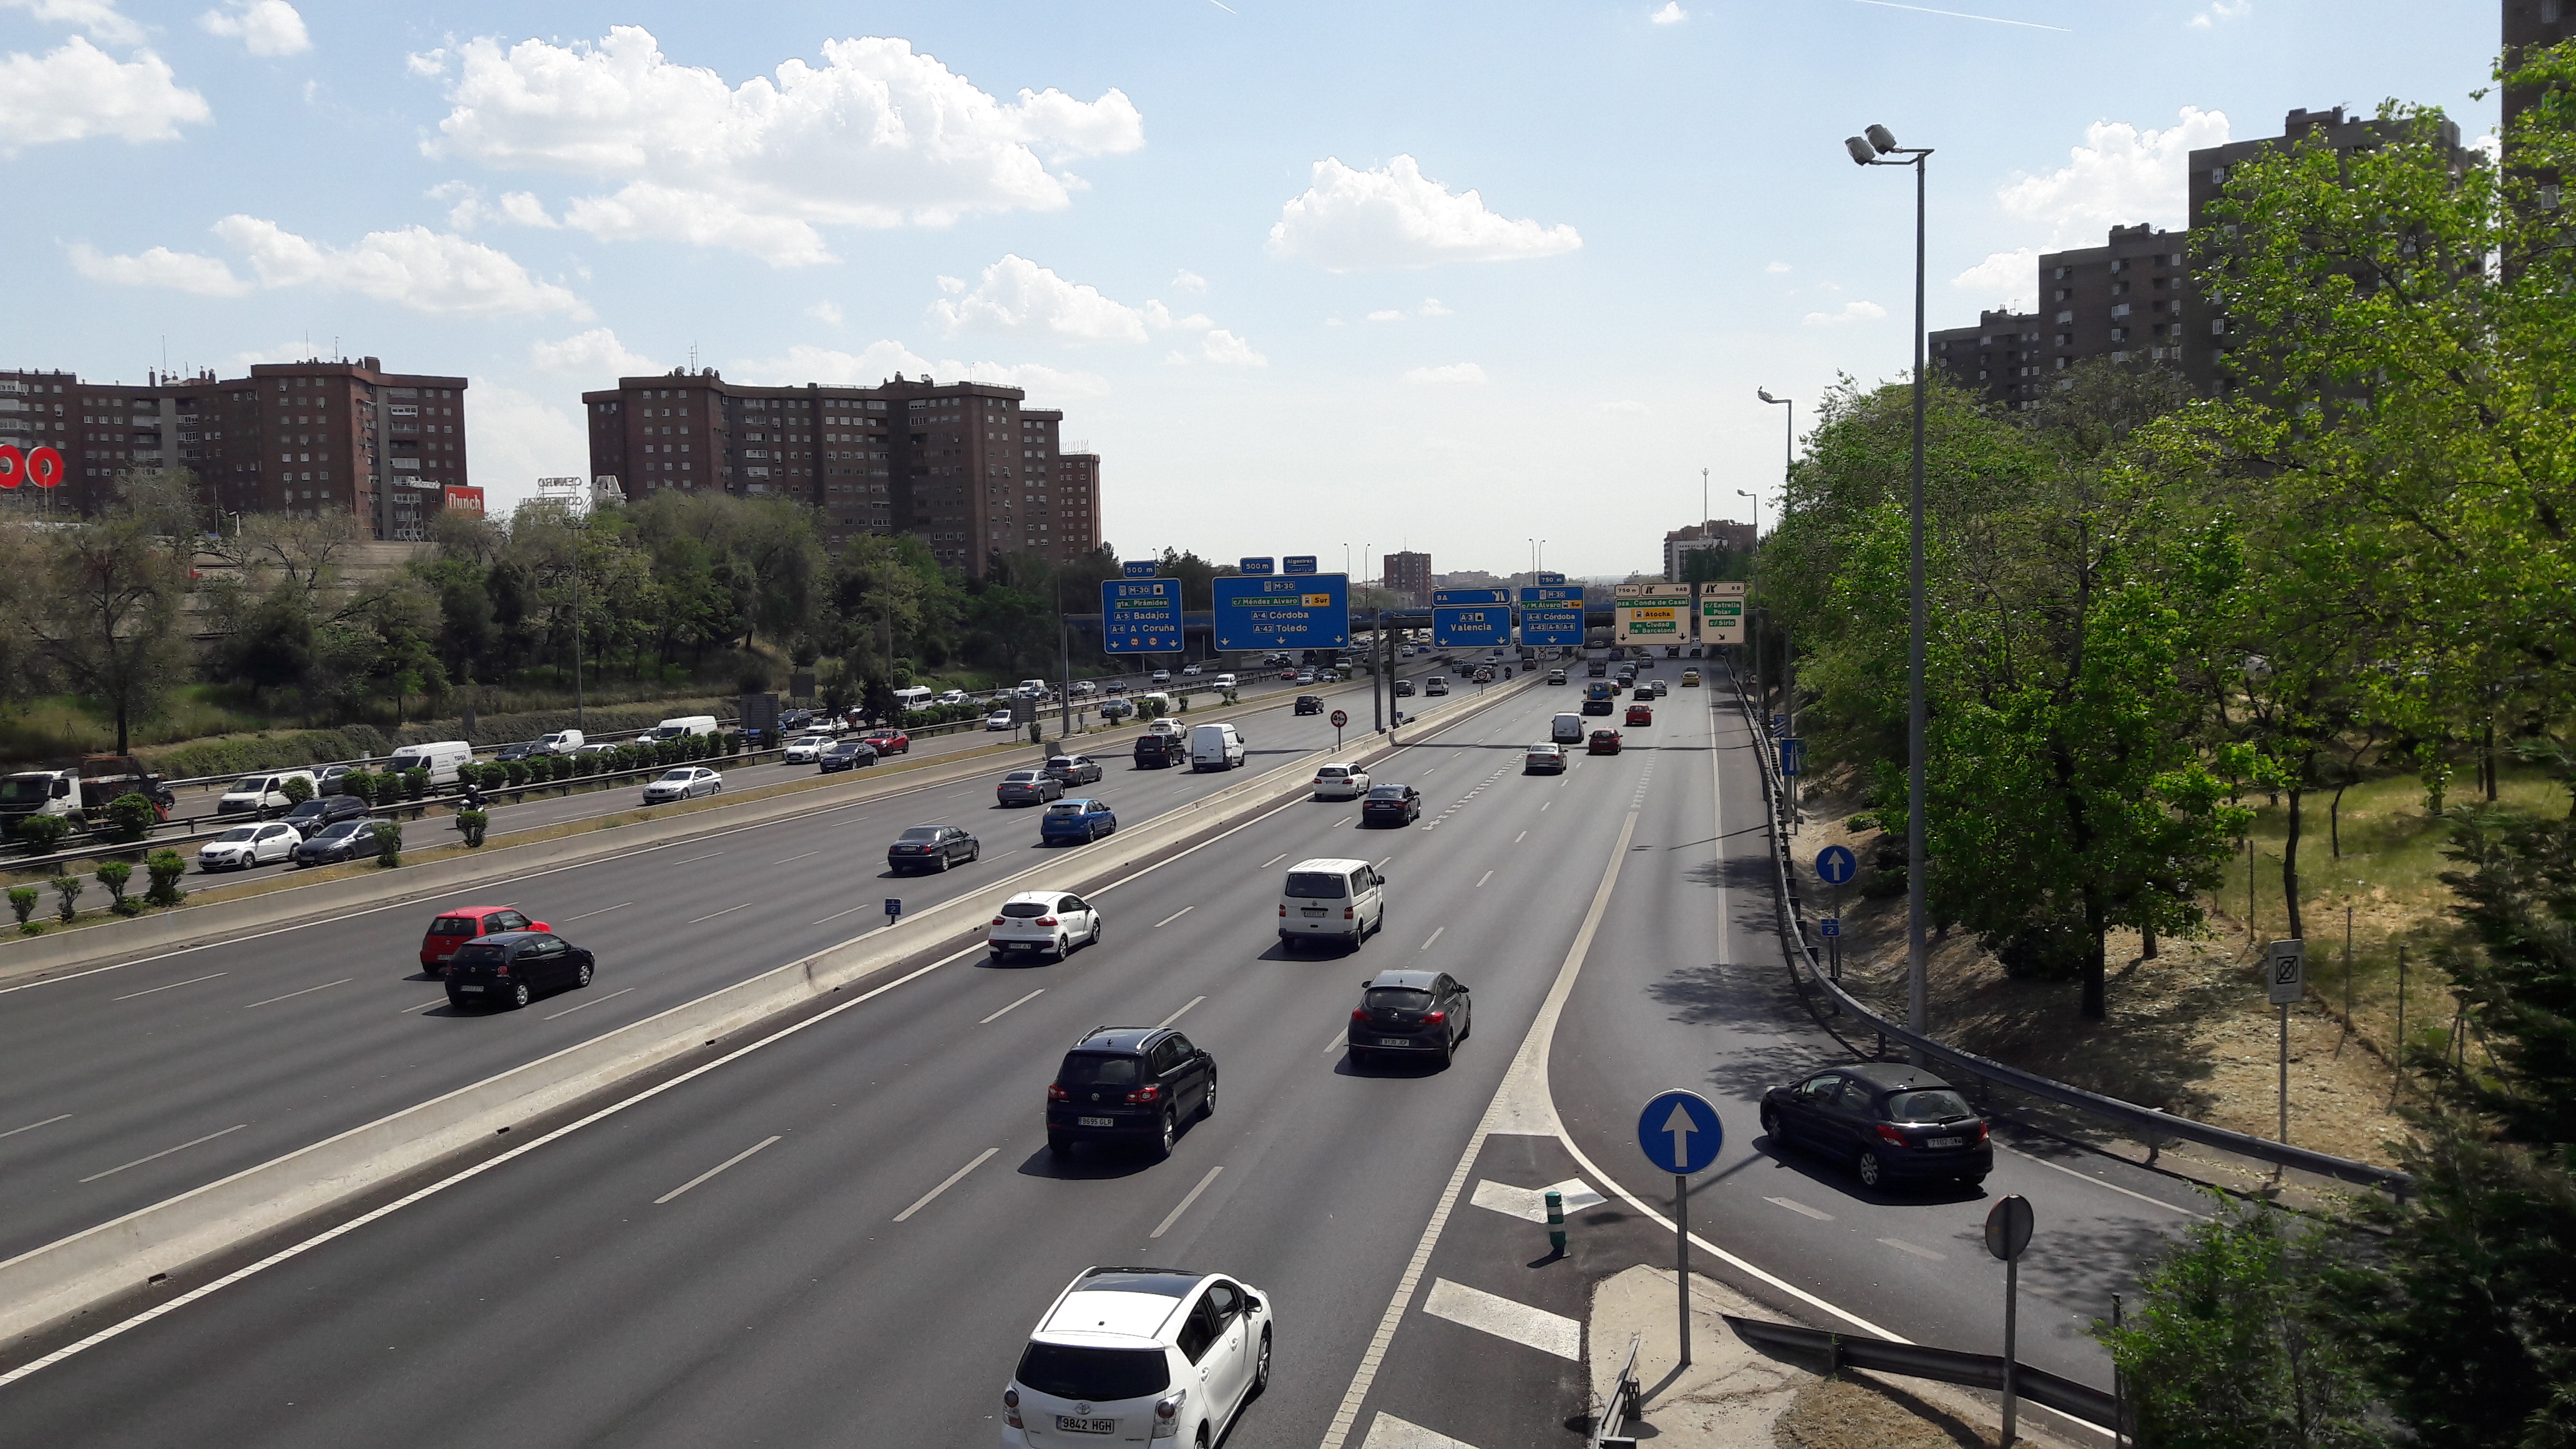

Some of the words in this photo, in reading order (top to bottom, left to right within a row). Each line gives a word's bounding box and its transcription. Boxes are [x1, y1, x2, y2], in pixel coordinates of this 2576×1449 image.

[448, 492, 482, 511] flunch
[1134, 610, 1169, 620] Badajoz
[1269, 611, 1309, 619] Córdoba
[1543, 612, 1576, 620] Córdoba
[1130, 625, 1137, 633] A
[1142, 624, 1175, 632] Coruña
[1276, 624, 1308, 632] Toledo
[1450, 623, 1492, 632] Valencia
[1827, 926, 1834, 935] 2
[1063, 1418, 1087, 1430] 9842
[1092, 1420, 1111, 1432] HGH
